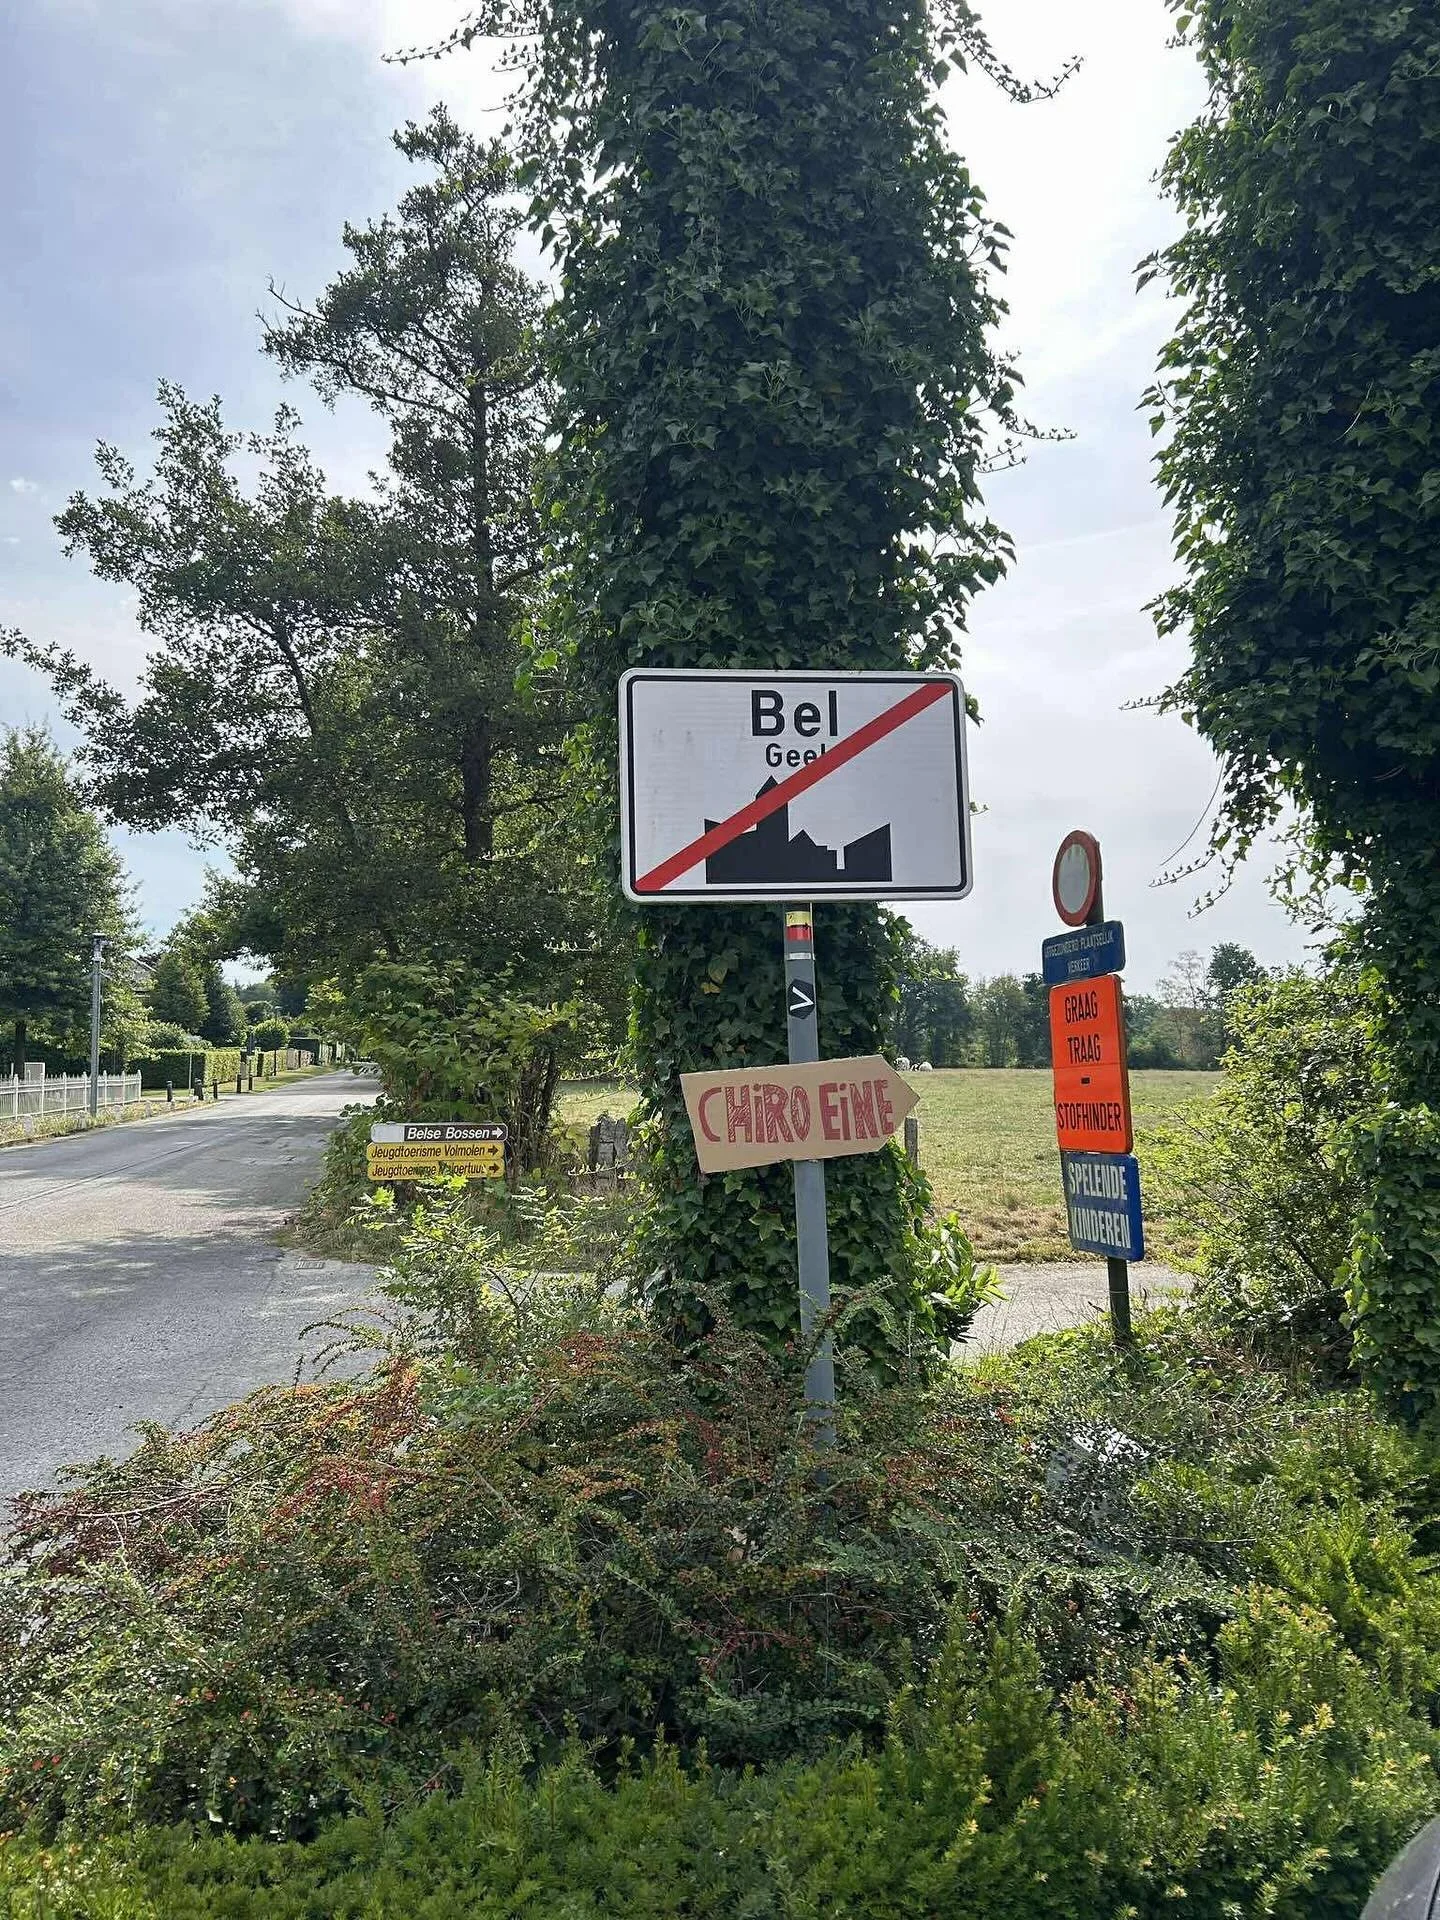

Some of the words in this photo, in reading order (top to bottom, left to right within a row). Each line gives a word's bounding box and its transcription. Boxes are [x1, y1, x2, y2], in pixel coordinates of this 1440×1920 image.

[751, 689, 838, 737] Bel
[766, 743, 826, 768] Geel
[1065, 991, 1098, 1024] GRAAG
[1067, 1034, 1101, 1064] TRAAG
[1057, 1102, 1122, 1131] STOFHINDER
[407, 1127, 441, 1139] Belse
[445, 1126, 490, 1139] Bossen
[371, 1145, 441, 1160] Jeugdtoerisme
[444, 1144, 485, 1156] Volmolen
[1068, 1162, 1128, 1200] SPELENDE
[1070, 1206, 1131, 1248] KINDEREN
